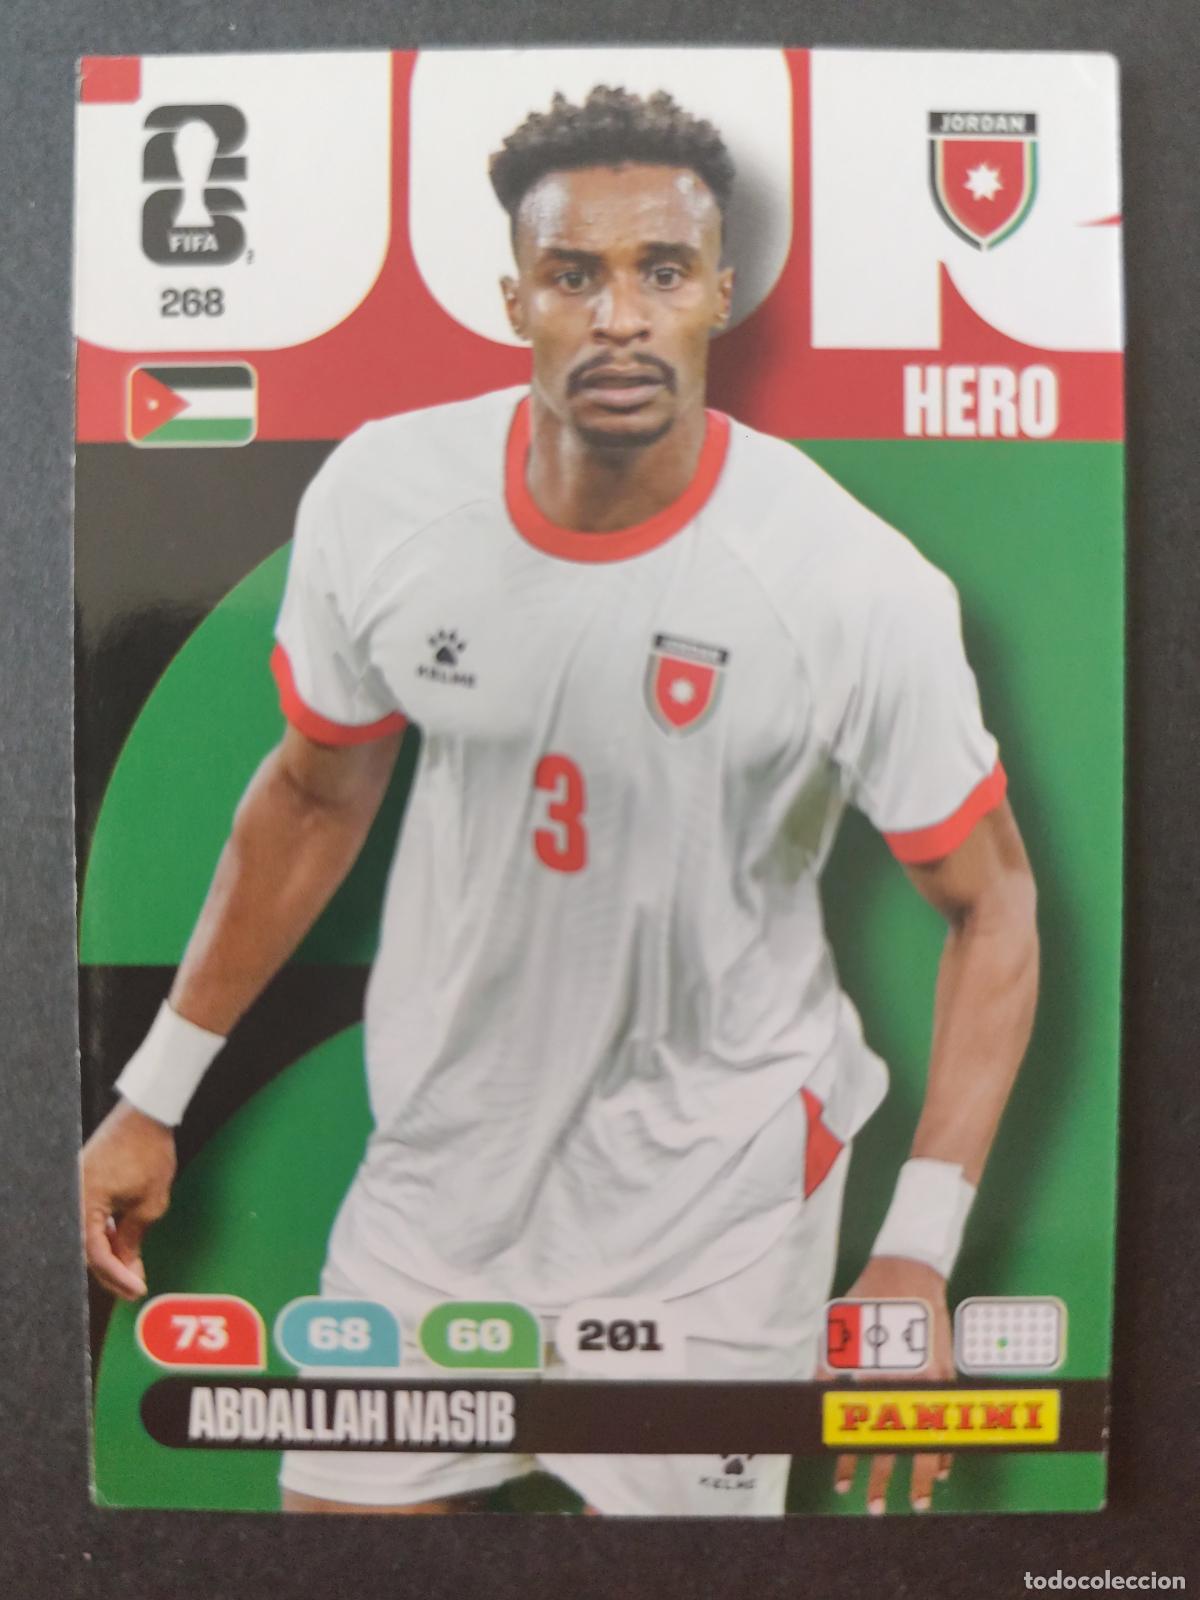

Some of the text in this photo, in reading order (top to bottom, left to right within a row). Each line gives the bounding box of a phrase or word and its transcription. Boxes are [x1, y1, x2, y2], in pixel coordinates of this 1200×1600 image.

[941, 114, 1026, 133] JORDAN
[168, 233, 219, 253] FIFA
[161, 288, 225, 318] 268
[903, 365, 1058, 438] HERO
[532, 753, 588, 873] 3
[171, 1315, 228, 1350] 73
[308, 1317, 371, 1351] 68
[448, 1317, 512, 1352] 60
[577, 1319, 663, 1352] 201
[188, 1386, 516, 1443] ABDALLAH NASIB
[840, 1401, 1045, 1432] PANINI
